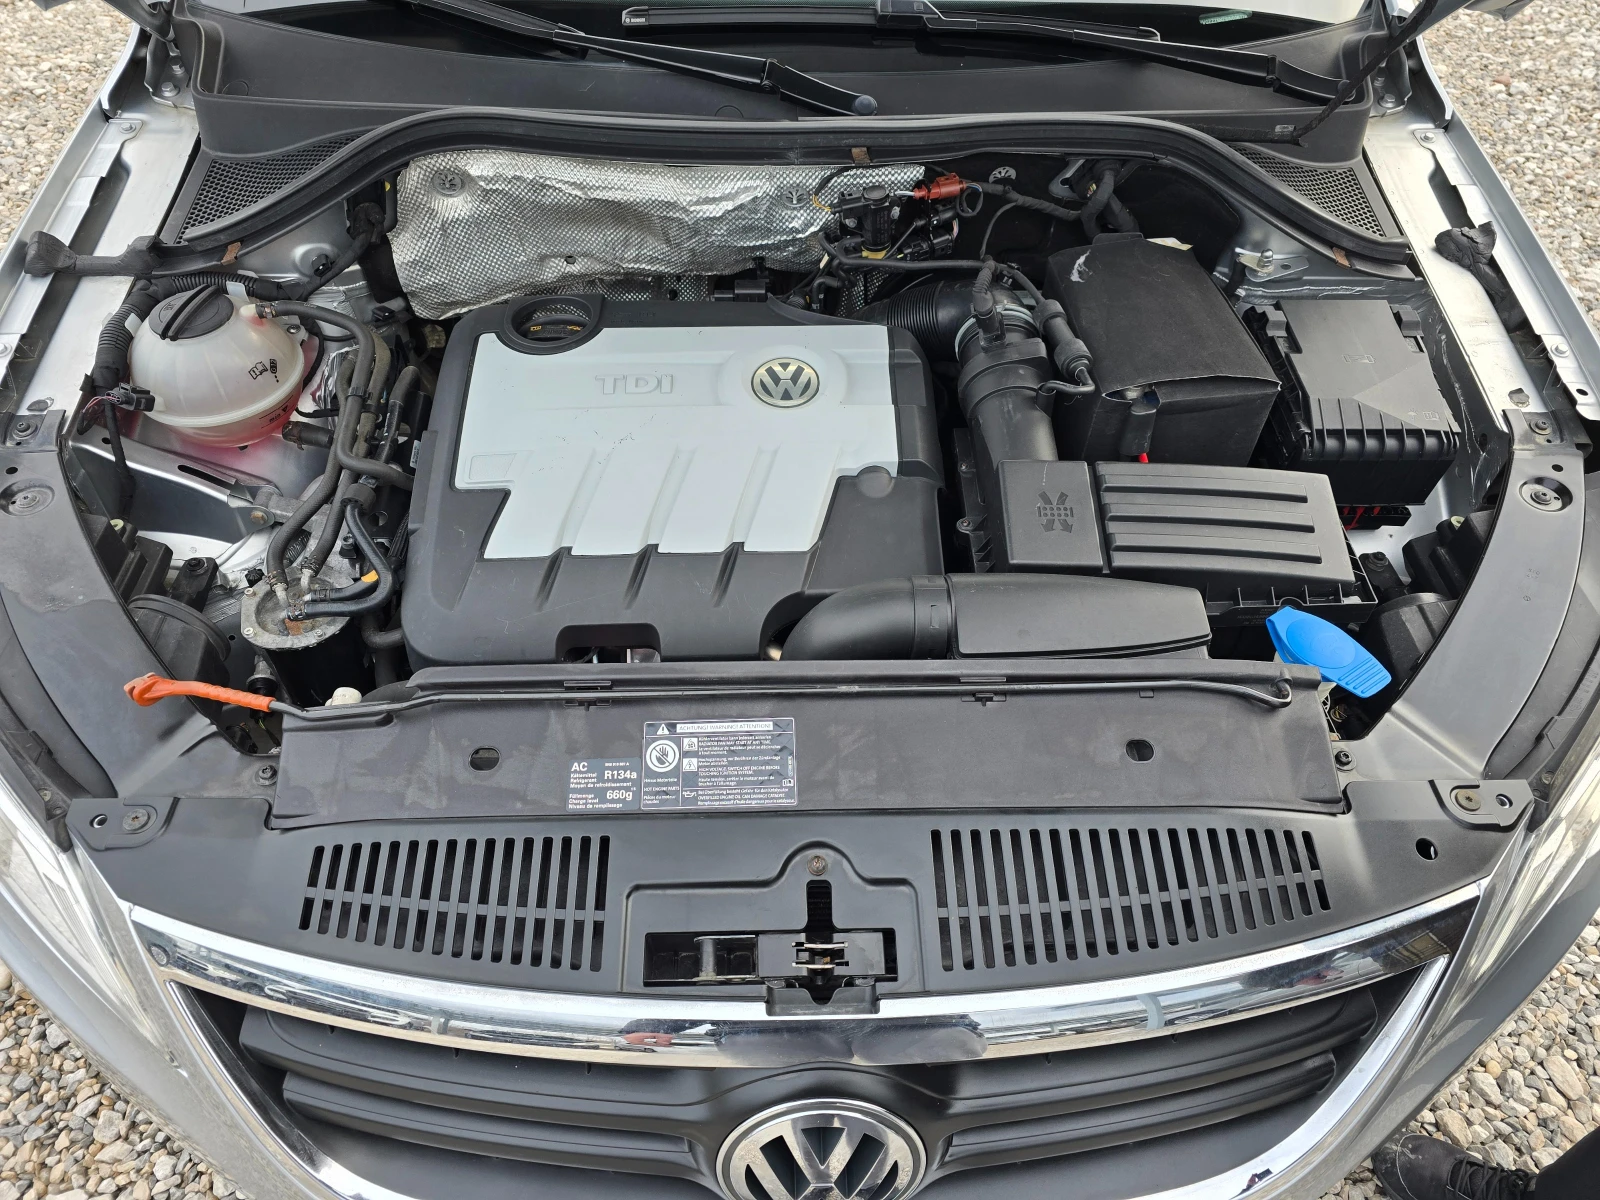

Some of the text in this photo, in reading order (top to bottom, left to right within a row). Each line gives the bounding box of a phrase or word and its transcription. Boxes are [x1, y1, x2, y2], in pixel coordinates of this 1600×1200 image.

[595, 374, 674, 395] TDI
[571, 762, 588, 771] AC
[604, 770, 637, 779] R134a
[606, 790, 632, 800] 660g
